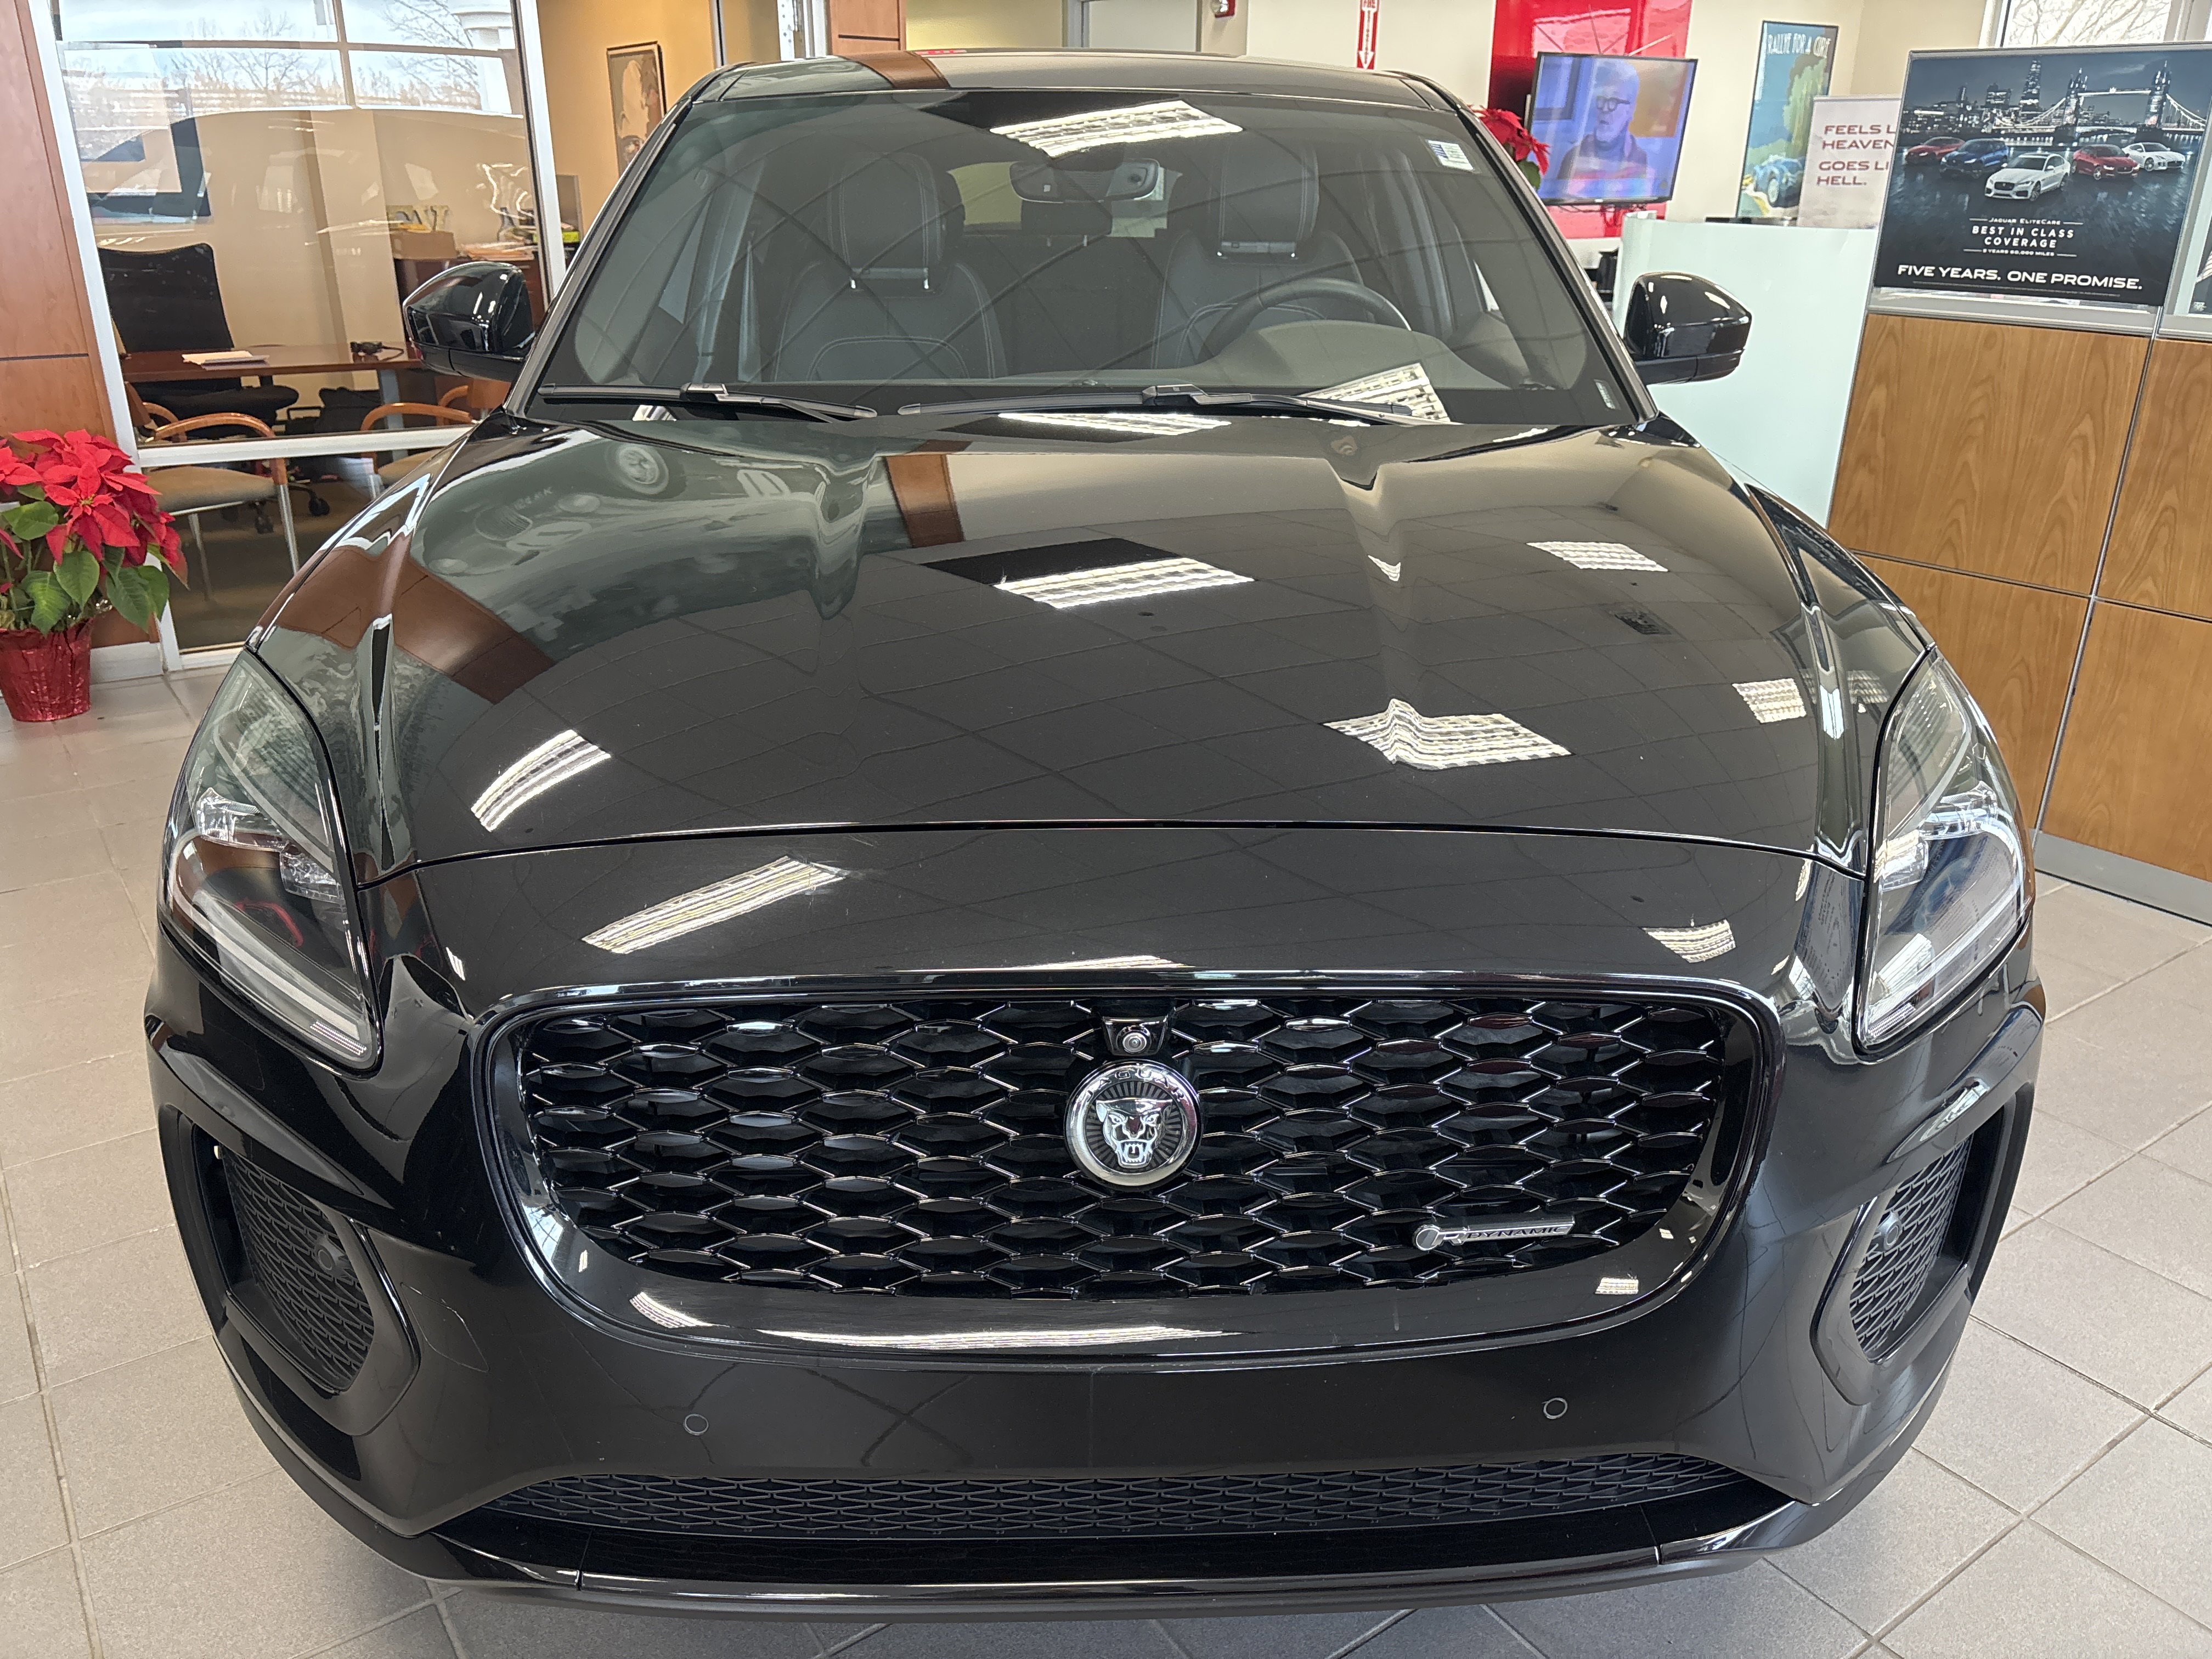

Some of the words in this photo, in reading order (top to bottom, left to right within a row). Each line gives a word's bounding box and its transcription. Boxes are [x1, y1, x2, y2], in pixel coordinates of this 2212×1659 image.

[1824, 125, 1882, 134] FEELS
[1818, 161, 1870, 171] GOES
[1874, 161, 1889, 171] LI
[1817, 176, 1867, 185] HELL.
[1972, 225, 2004, 235] BEST
[2011, 227, 2024, 236] IN
[2031, 228, 2074, 238] CLASS
[1984, 237, 2057, 248] COVERAGE
[1898, 264, 1936, 276] FIVE
[1938, 267, 2001, 280] YEARS.
[2007, 270, 2047, 283] ONE
[2050, 273, 2142, 290] PROMISE.
[1087, 1068, 1184, 1102] JAGUAR
